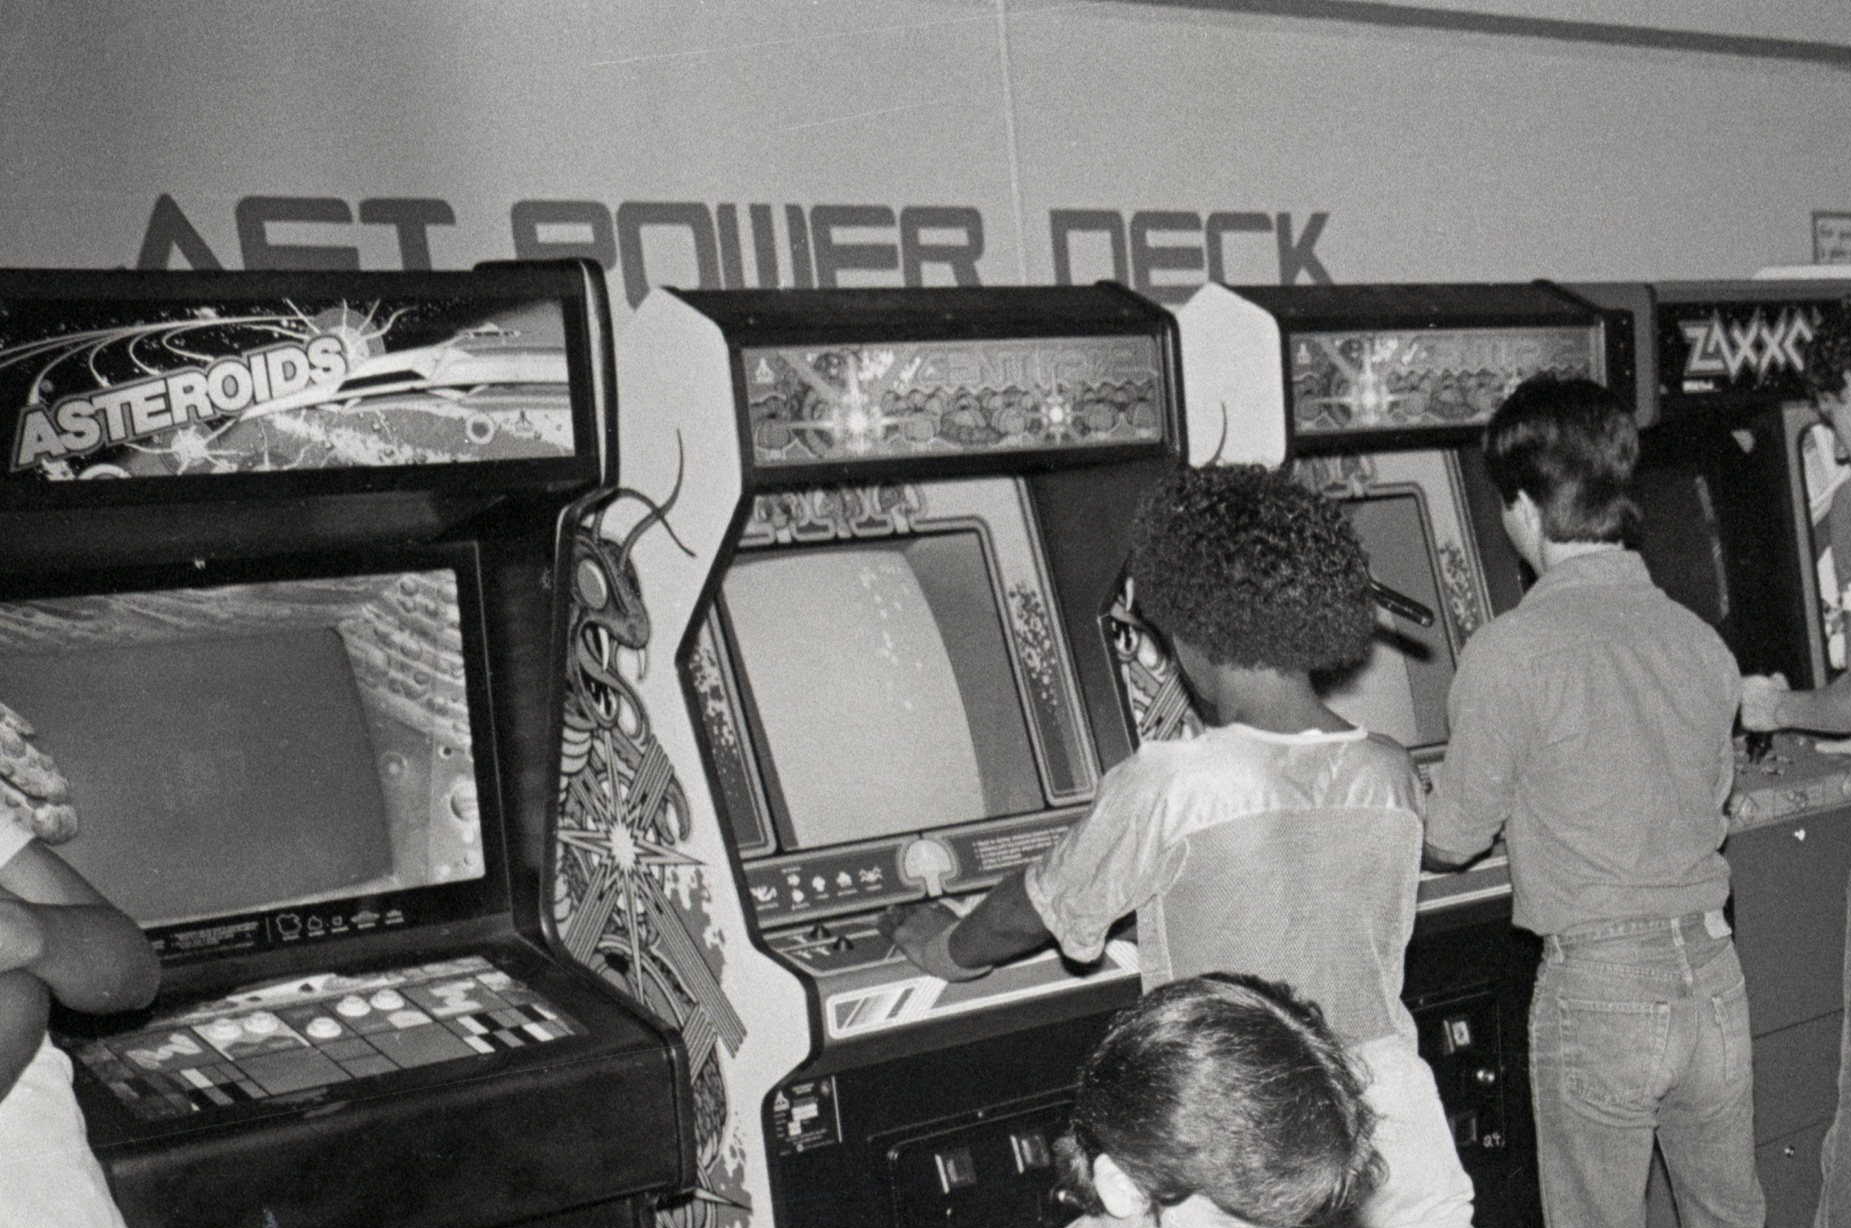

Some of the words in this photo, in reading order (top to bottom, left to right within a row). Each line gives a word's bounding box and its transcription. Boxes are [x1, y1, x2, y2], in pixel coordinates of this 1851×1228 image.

[510, 199, 985, 312] POWER
[1049, 207, 1333, 304] DECK
[14, 334, 349, 468] ASTEROIDS
